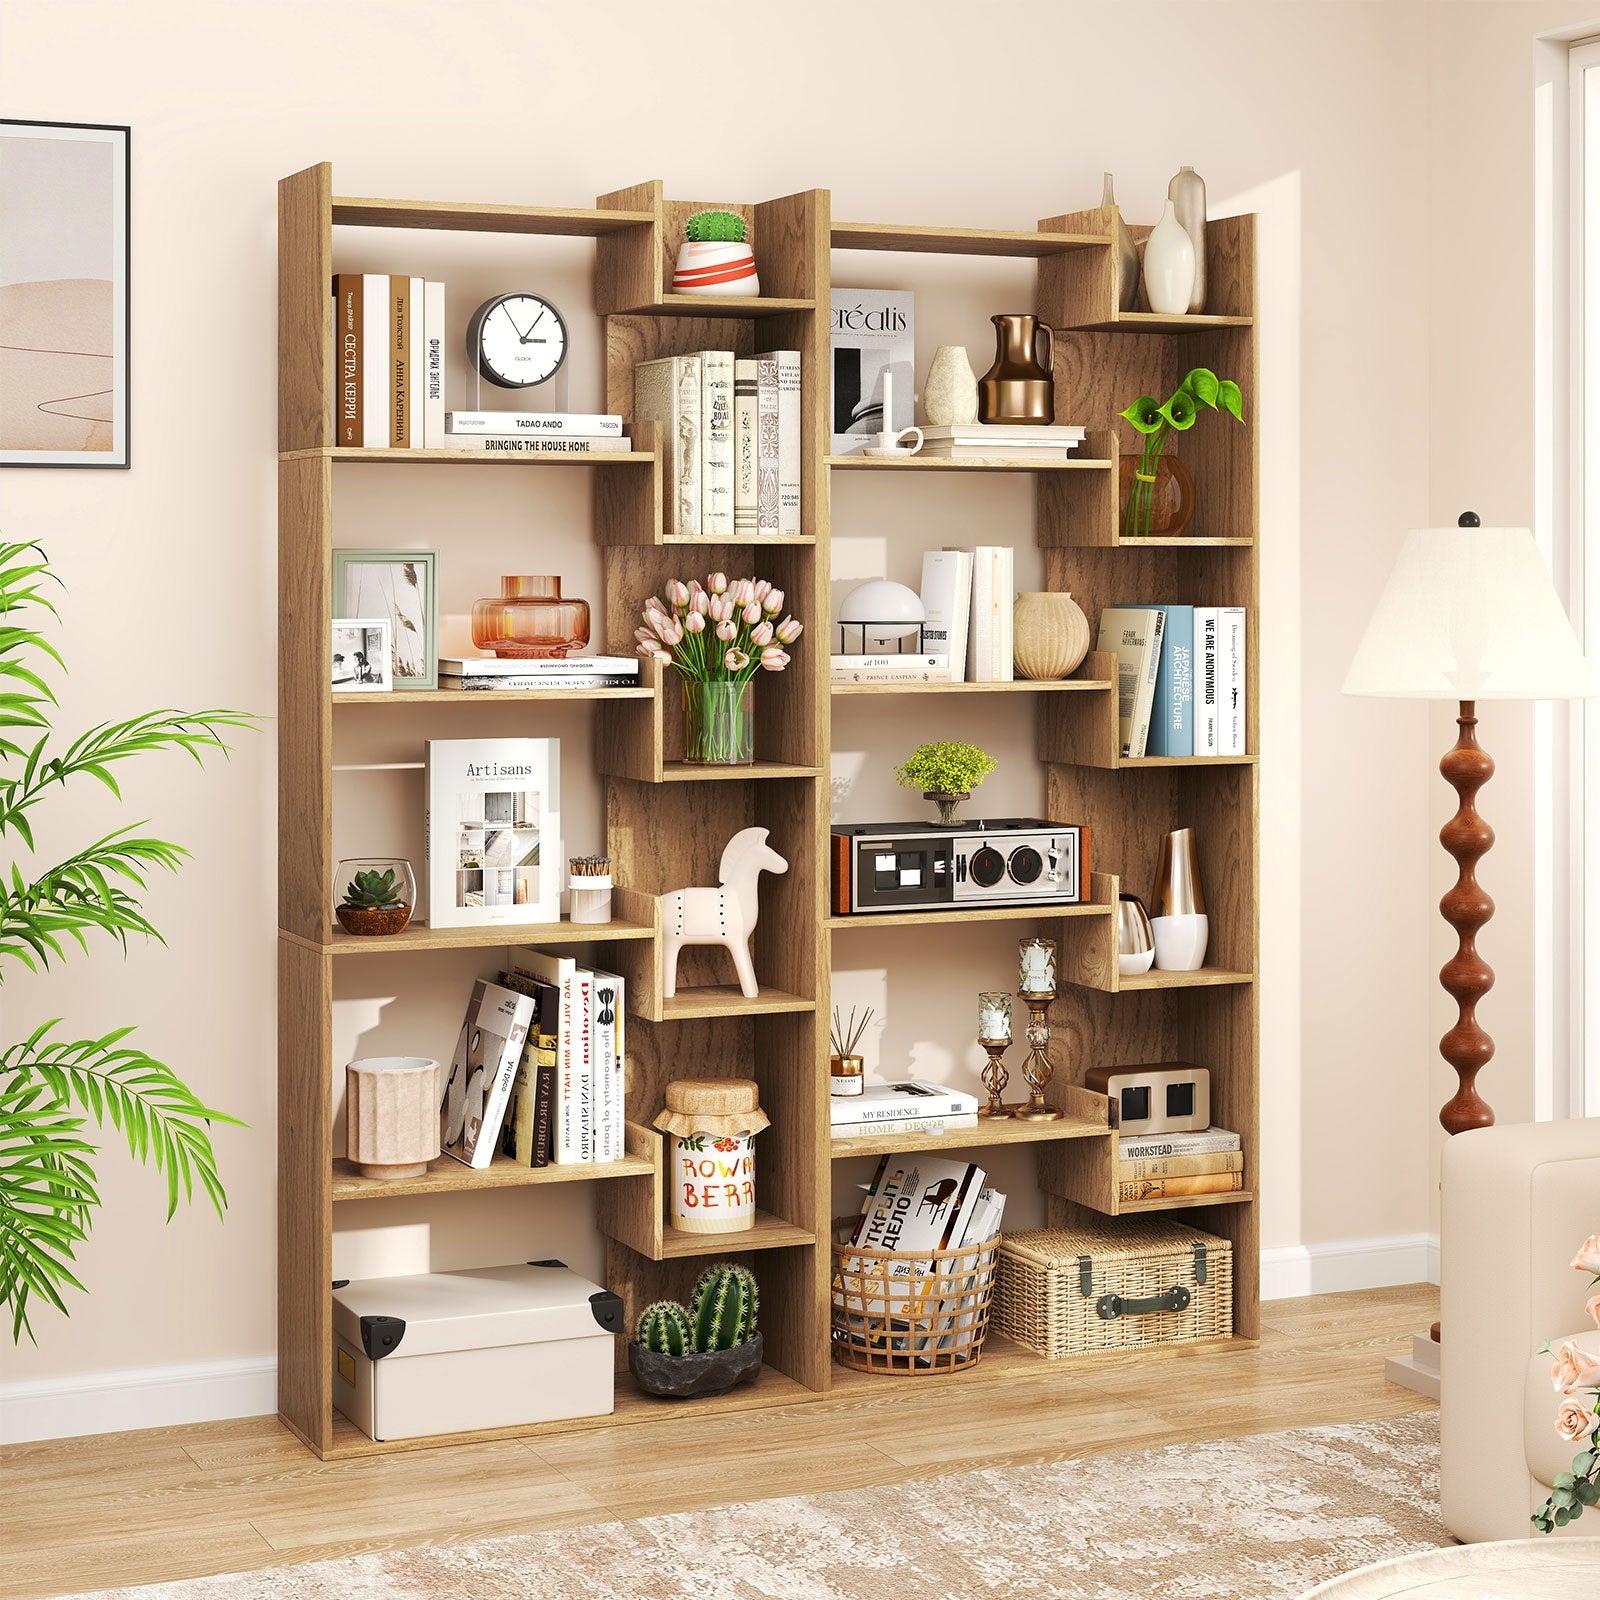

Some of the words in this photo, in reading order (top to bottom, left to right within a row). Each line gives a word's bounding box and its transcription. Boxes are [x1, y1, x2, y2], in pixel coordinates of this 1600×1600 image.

[344, 333, 356, 379] СЕСТРА
[429, 338, 440, 370] ФРИДРИХ
[429, 371, 440, 400] ЭНГЕЛЬС
[344, 382, 356, 420] КЕРРИ
[516, 419, 541, 429] TADAO
[542, 420, 563, 429] ANDO
[485, 439, 523, 451] BRINGING
[525, 440, 540, 452] THE
[541, 441, 567, 452] HOUSE
[569, 441, 590, 452] HOME
[1205, 619, 1215, 632] WE
[1205, 634, 1215, 651] ARE
[508, 680, 585, 688] MOCKINGBIRD
[1181, 646, 1190, 702] JAPANESE
[1205, 652, 1215, 705] ANONYMOUS
[1173, 645, 1182, 730] ARCHITECTURE
[466, 762, 532, 777] Artisans
[862, 1111, 875, 1119] MY
[876, 1107, 920, 1118] RESIDENCE
[858, 1123, 895, 1135] HOME
[1127, 1144, 1173, 1158] WORKSTEAD
[682, 1154, 756, 1178] ROWA
[683, 1180, 756, 1208] BERR
[881, 1197, 912, 1251] ДЕЛО
[893, 1265, 926, 1276] ДИЗЙН
